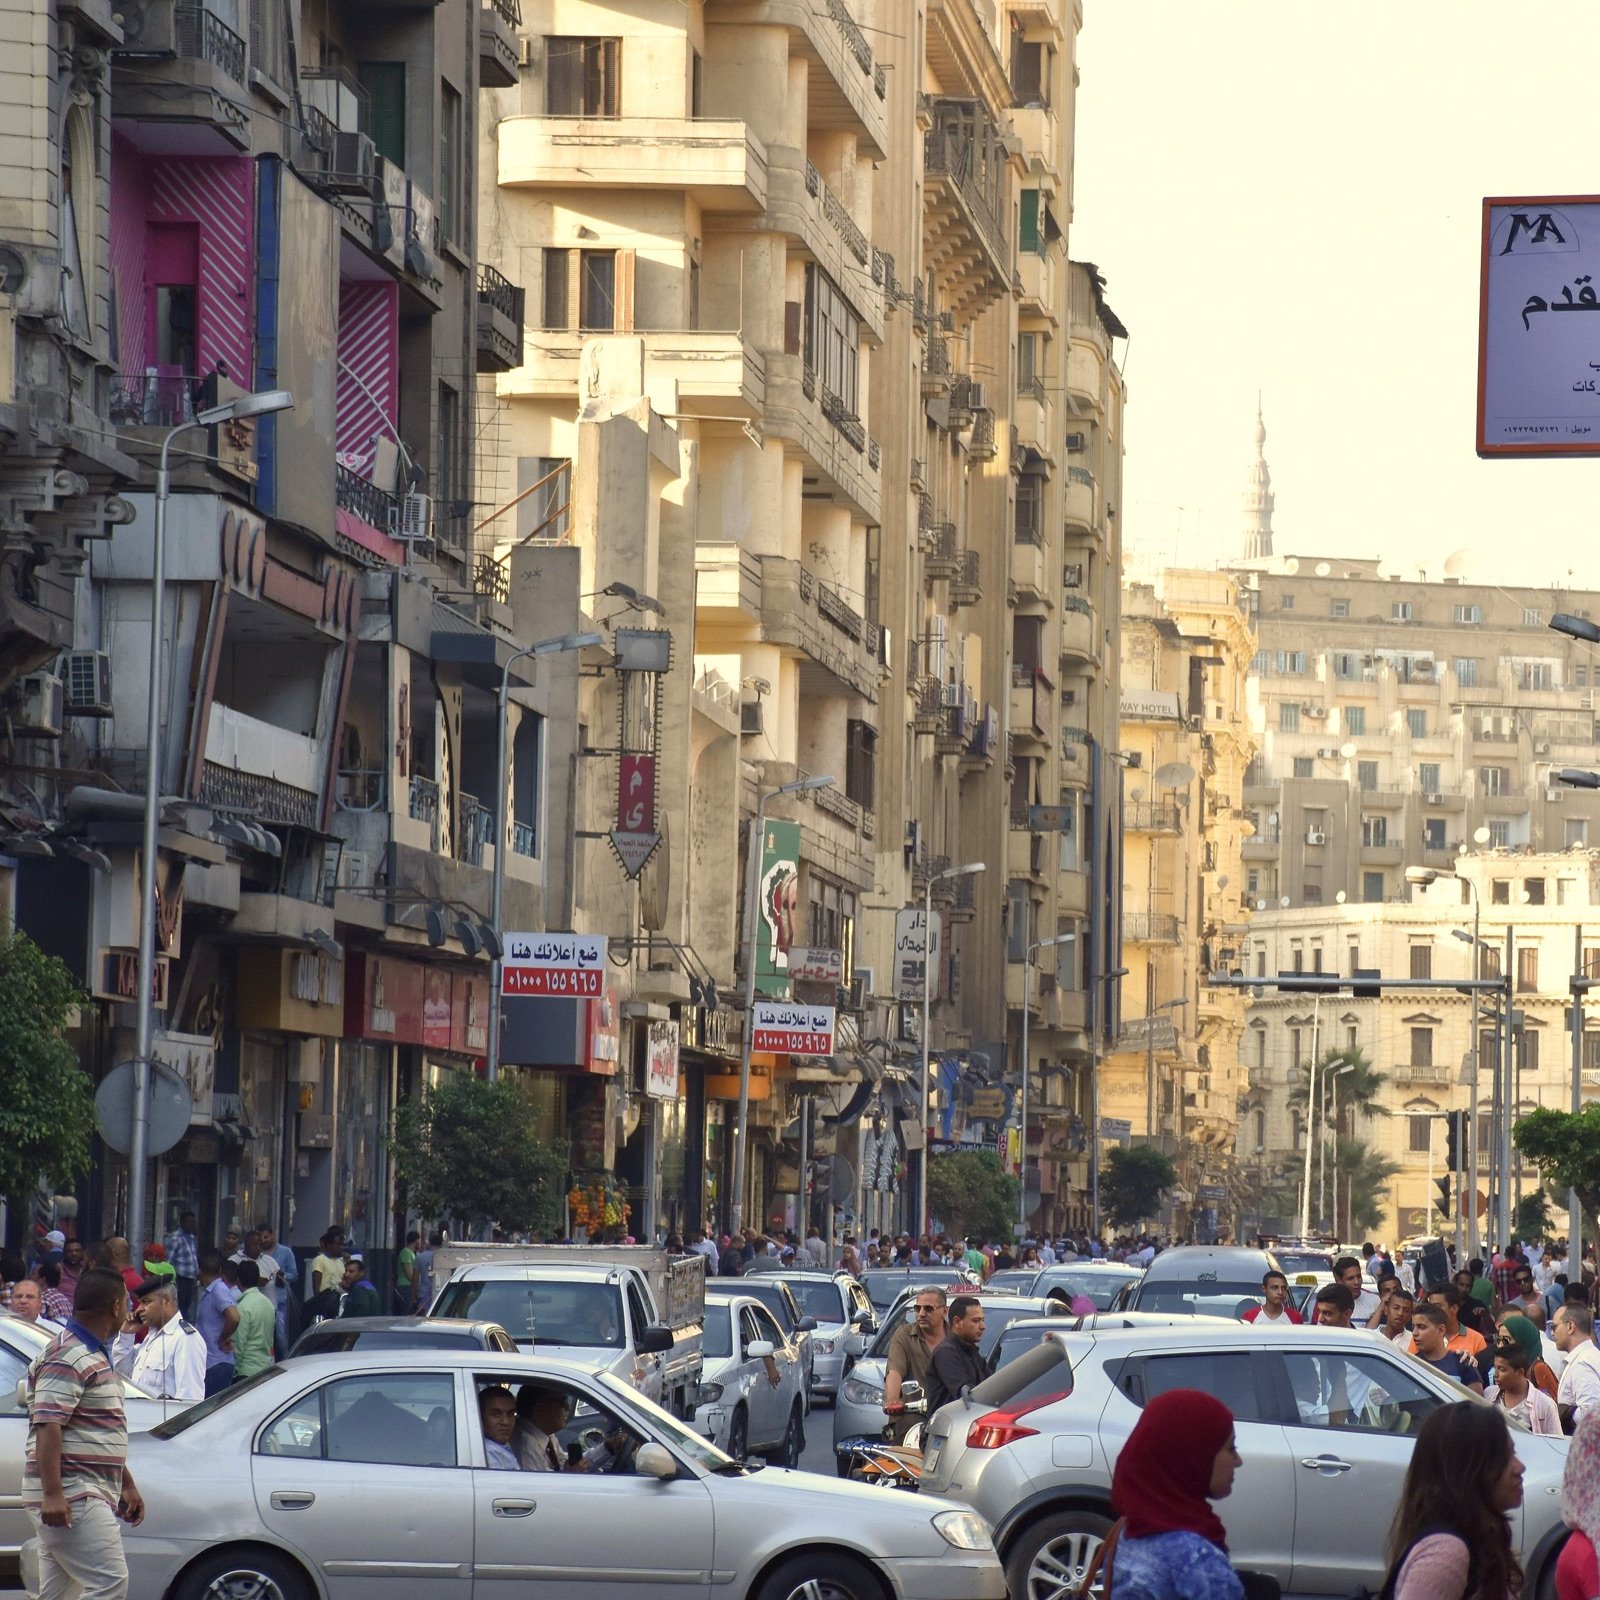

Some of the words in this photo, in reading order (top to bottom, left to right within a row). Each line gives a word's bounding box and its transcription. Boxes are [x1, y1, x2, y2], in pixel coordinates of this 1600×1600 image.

[1500, 214, 1567, 256] MA
[1522, 275, 1600, 332] قدم
[1141, 703, 1174, 716] HOTEL
[511, 942, 532, 959] هنا
[578, 946, 599, 968] ضع
[509, 969, 541, 991] ٠١٠٠٠
[545, 971, 567, 991] ١٥٥
[570, 971, 597, 993] ٩٦٥
[760, 1011, 776, 1024] هنا
[812, 1015, 828, 1032] ضع
[758, 1032, 784, 1048] ٠١٠٠٠
[786, 1034, 803, 1050] ١٥٥
[805, 1034, 827, 1052] ٩٦٥
